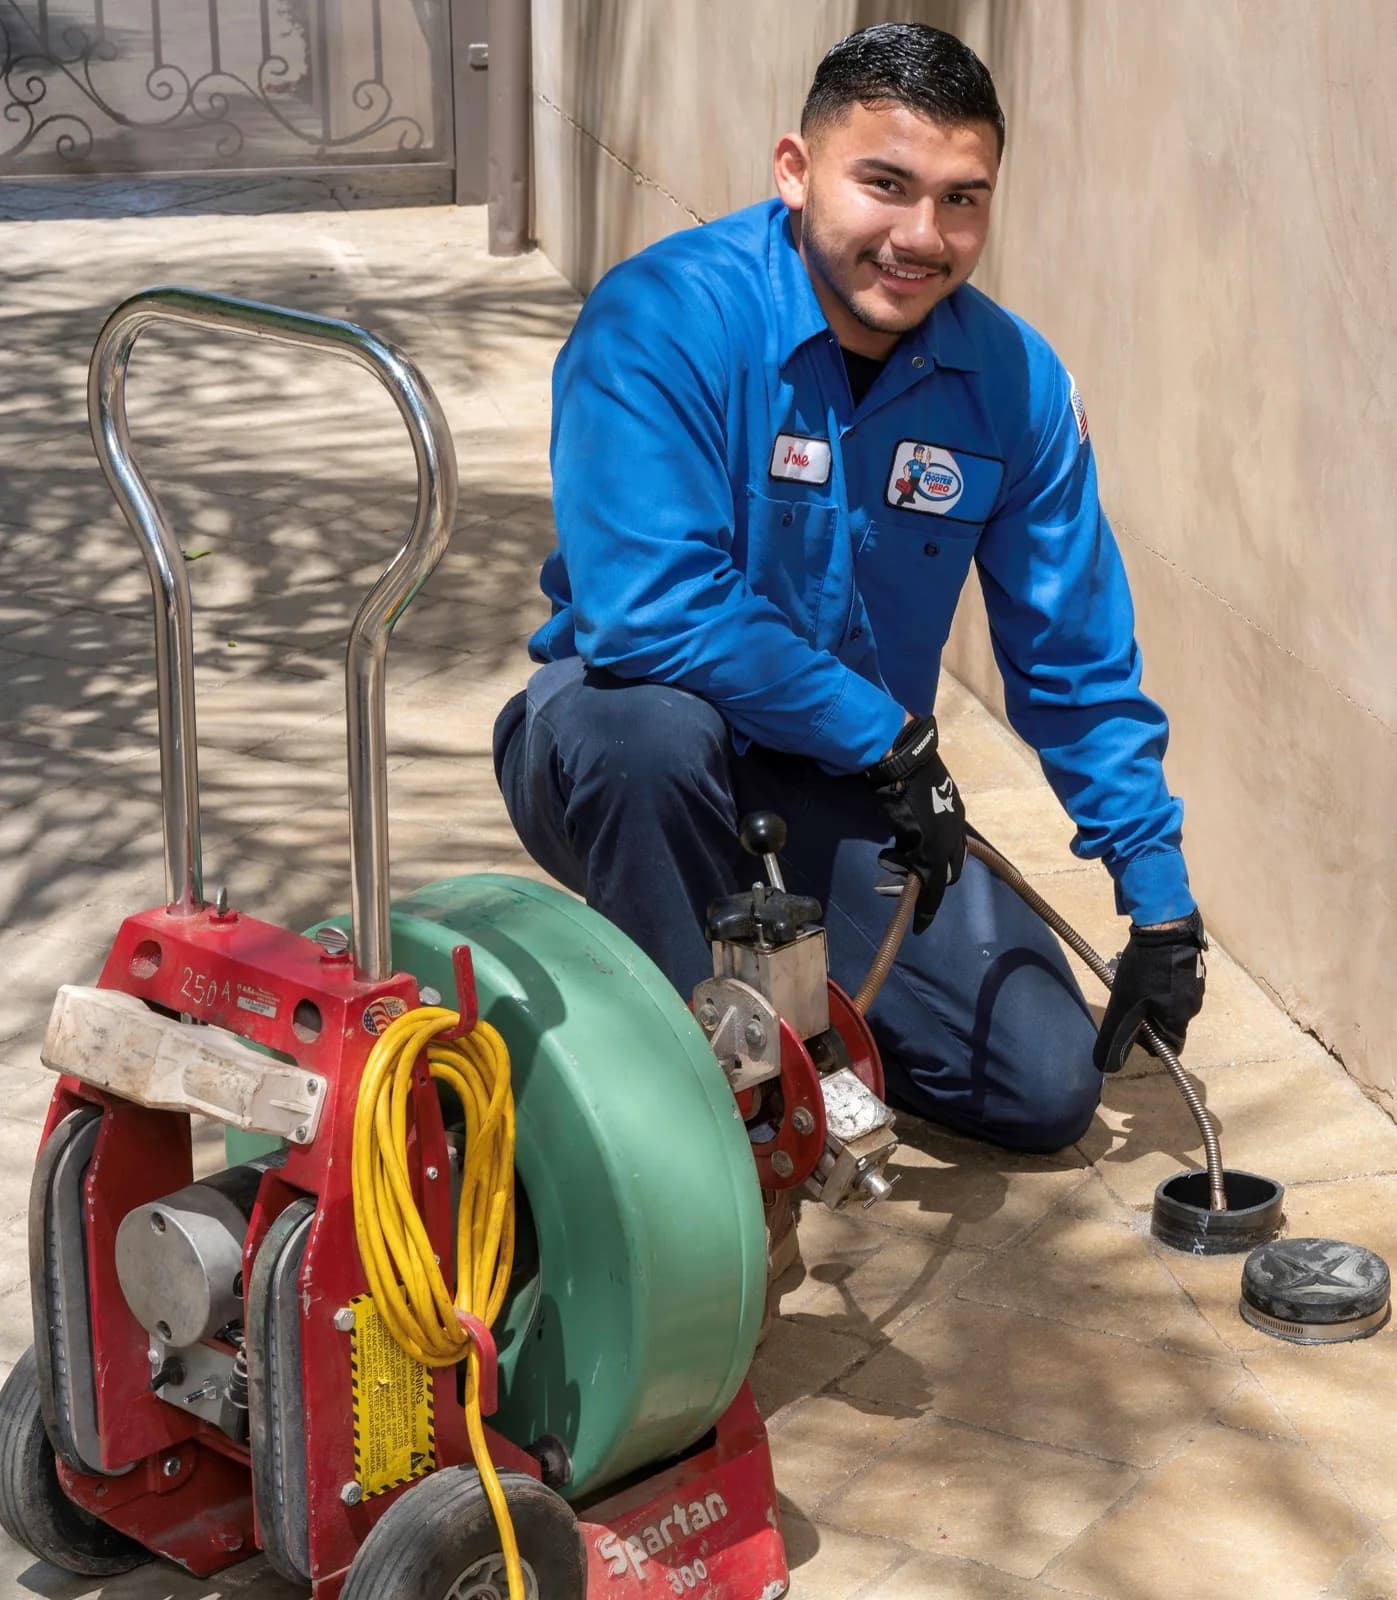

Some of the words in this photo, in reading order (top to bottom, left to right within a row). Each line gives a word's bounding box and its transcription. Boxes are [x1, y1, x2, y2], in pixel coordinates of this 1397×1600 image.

[924, 472, 953, 486] ROOTER
[928, 482, 950, 493] HERO
[596, 1493, 728, 1580] Spartan
[667, 1558, 708, 1595] 300
